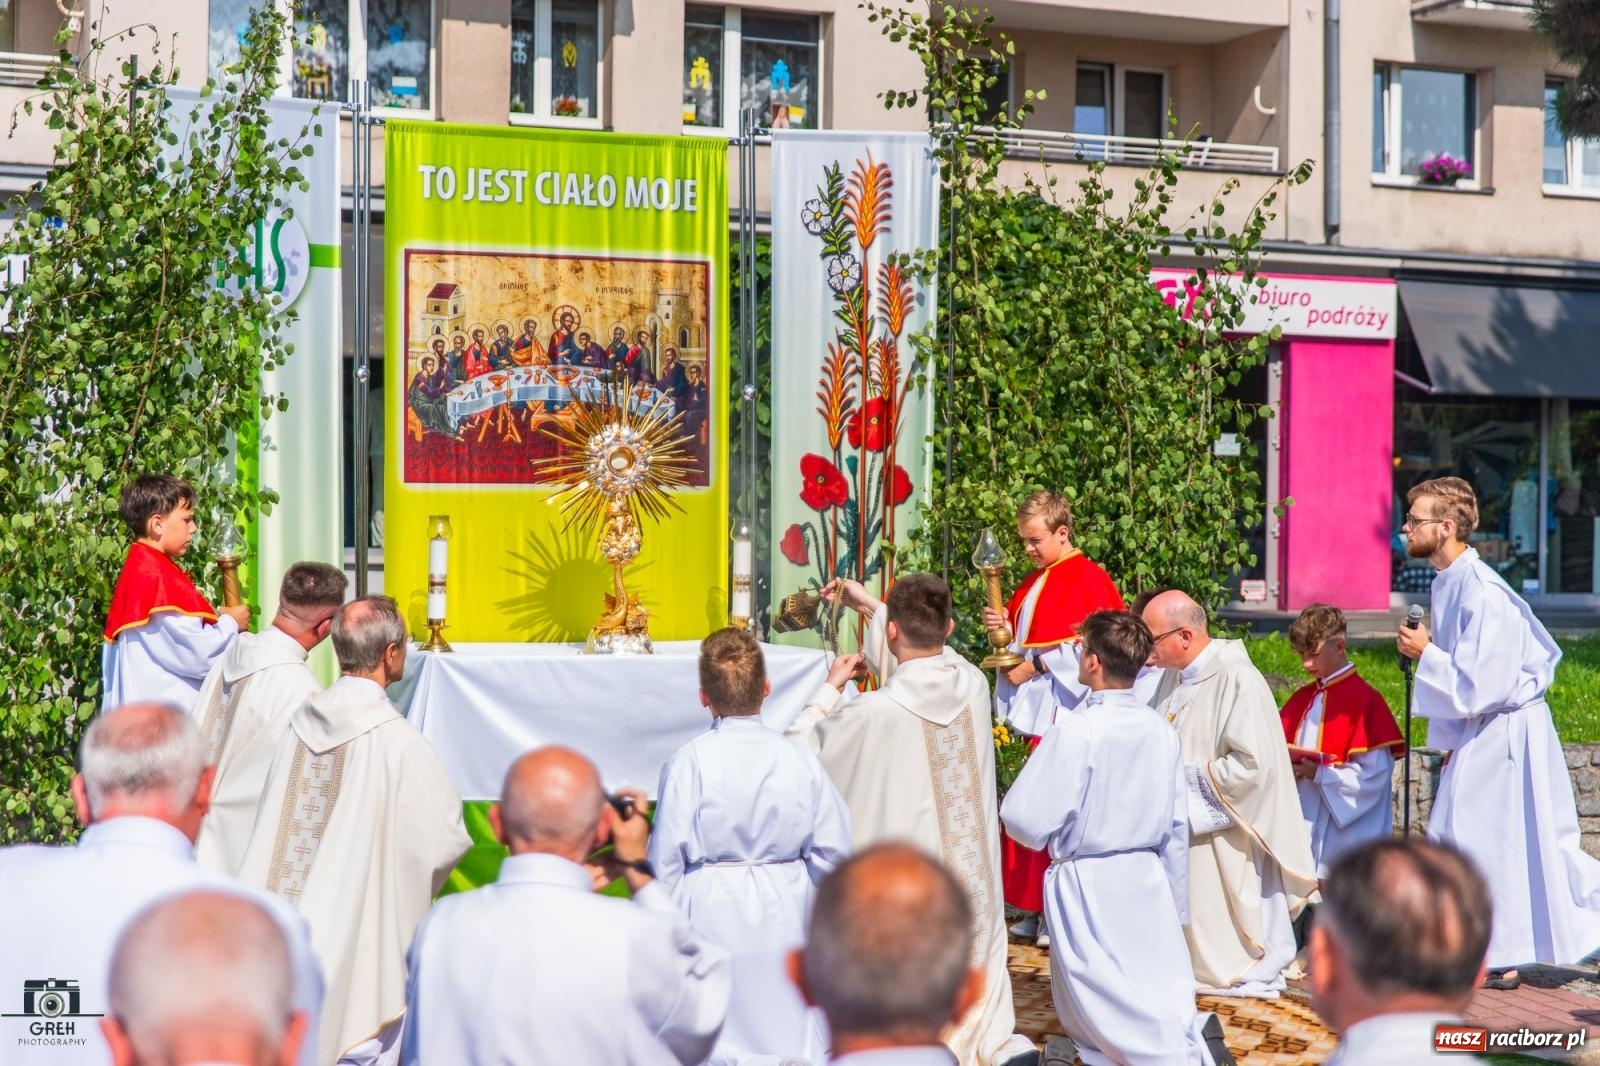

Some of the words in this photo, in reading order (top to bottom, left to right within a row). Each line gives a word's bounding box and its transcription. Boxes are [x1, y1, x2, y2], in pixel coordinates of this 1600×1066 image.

[418, 164, 456, 200] TO
[462, 167, 528, 203] JEST
[535, 170, 616, 208] CIAŁO
[624, 175, 697, 212] MOJE
[1258, 285, 1312, 306] biuro
[1307, 305, 1389, 331] podróży
